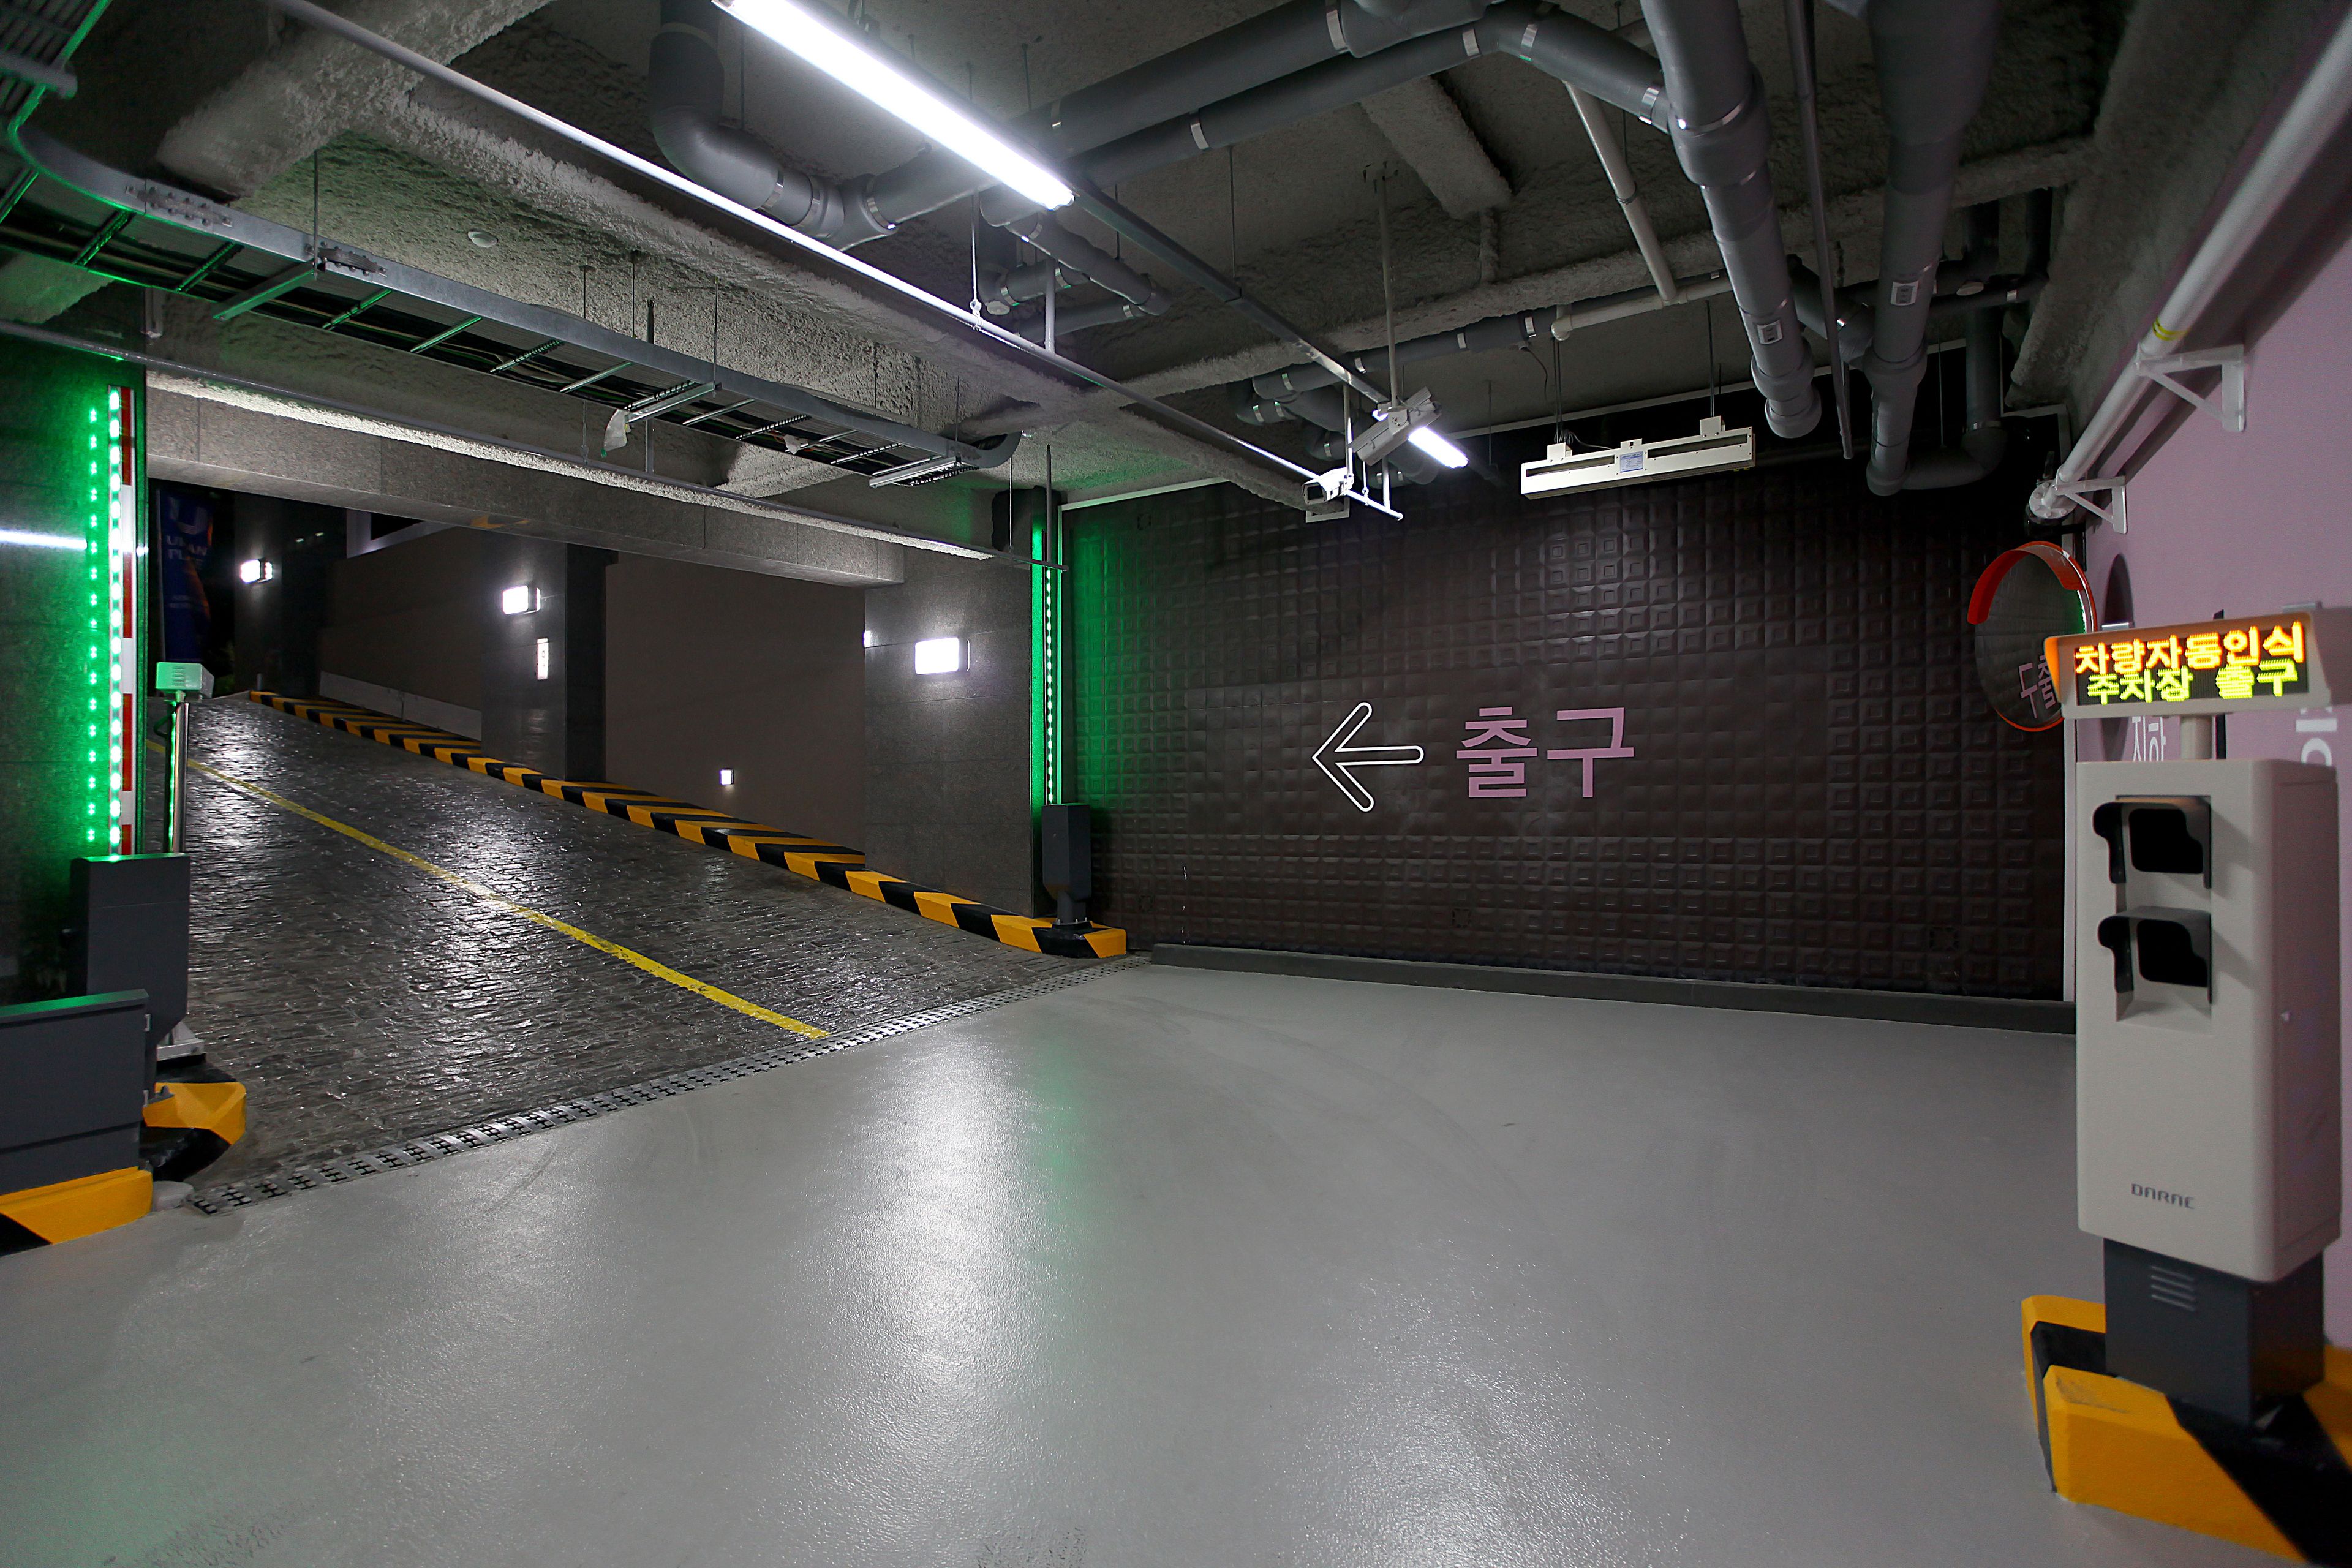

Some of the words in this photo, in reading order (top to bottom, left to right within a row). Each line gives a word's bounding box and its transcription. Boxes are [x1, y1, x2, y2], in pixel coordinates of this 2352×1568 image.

[2075, 620, 2305, 675] 차량자동인식
[2087, 665, 2193, 706] 주차장
[2215, 658, 2299, 699] 출구
[1455, 706, 1635, 799] 출구
